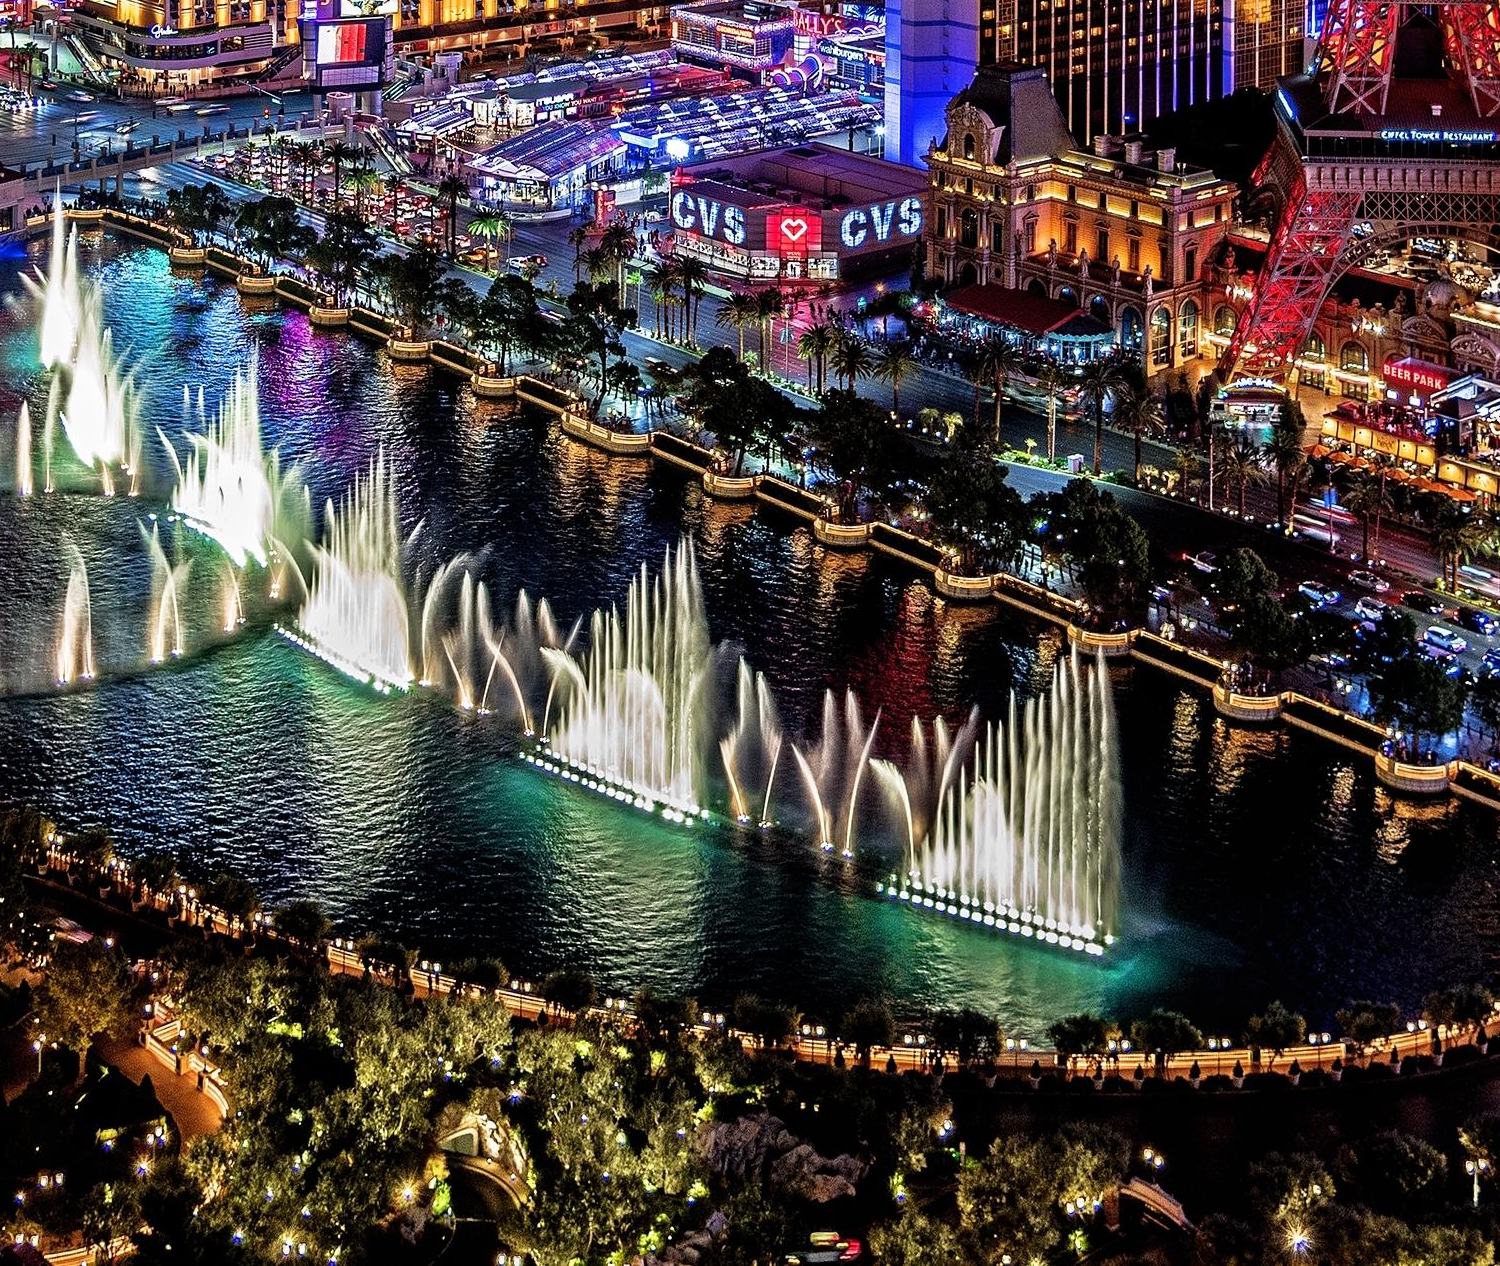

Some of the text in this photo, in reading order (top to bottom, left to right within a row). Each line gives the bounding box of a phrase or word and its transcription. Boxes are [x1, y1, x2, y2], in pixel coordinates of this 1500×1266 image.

[793, 10, 841, 35] BALLY'S
[554, 102, 570, 110] KNOW
[1411, 131, 1440, 140] TOWER
[1443, 132, 1493, 141] RESTAURANT
[672, 191, 746, 245] CVS
[841, 196, 922, 248] CVS
[1383, 364, 1442, 389] BEER PARK
